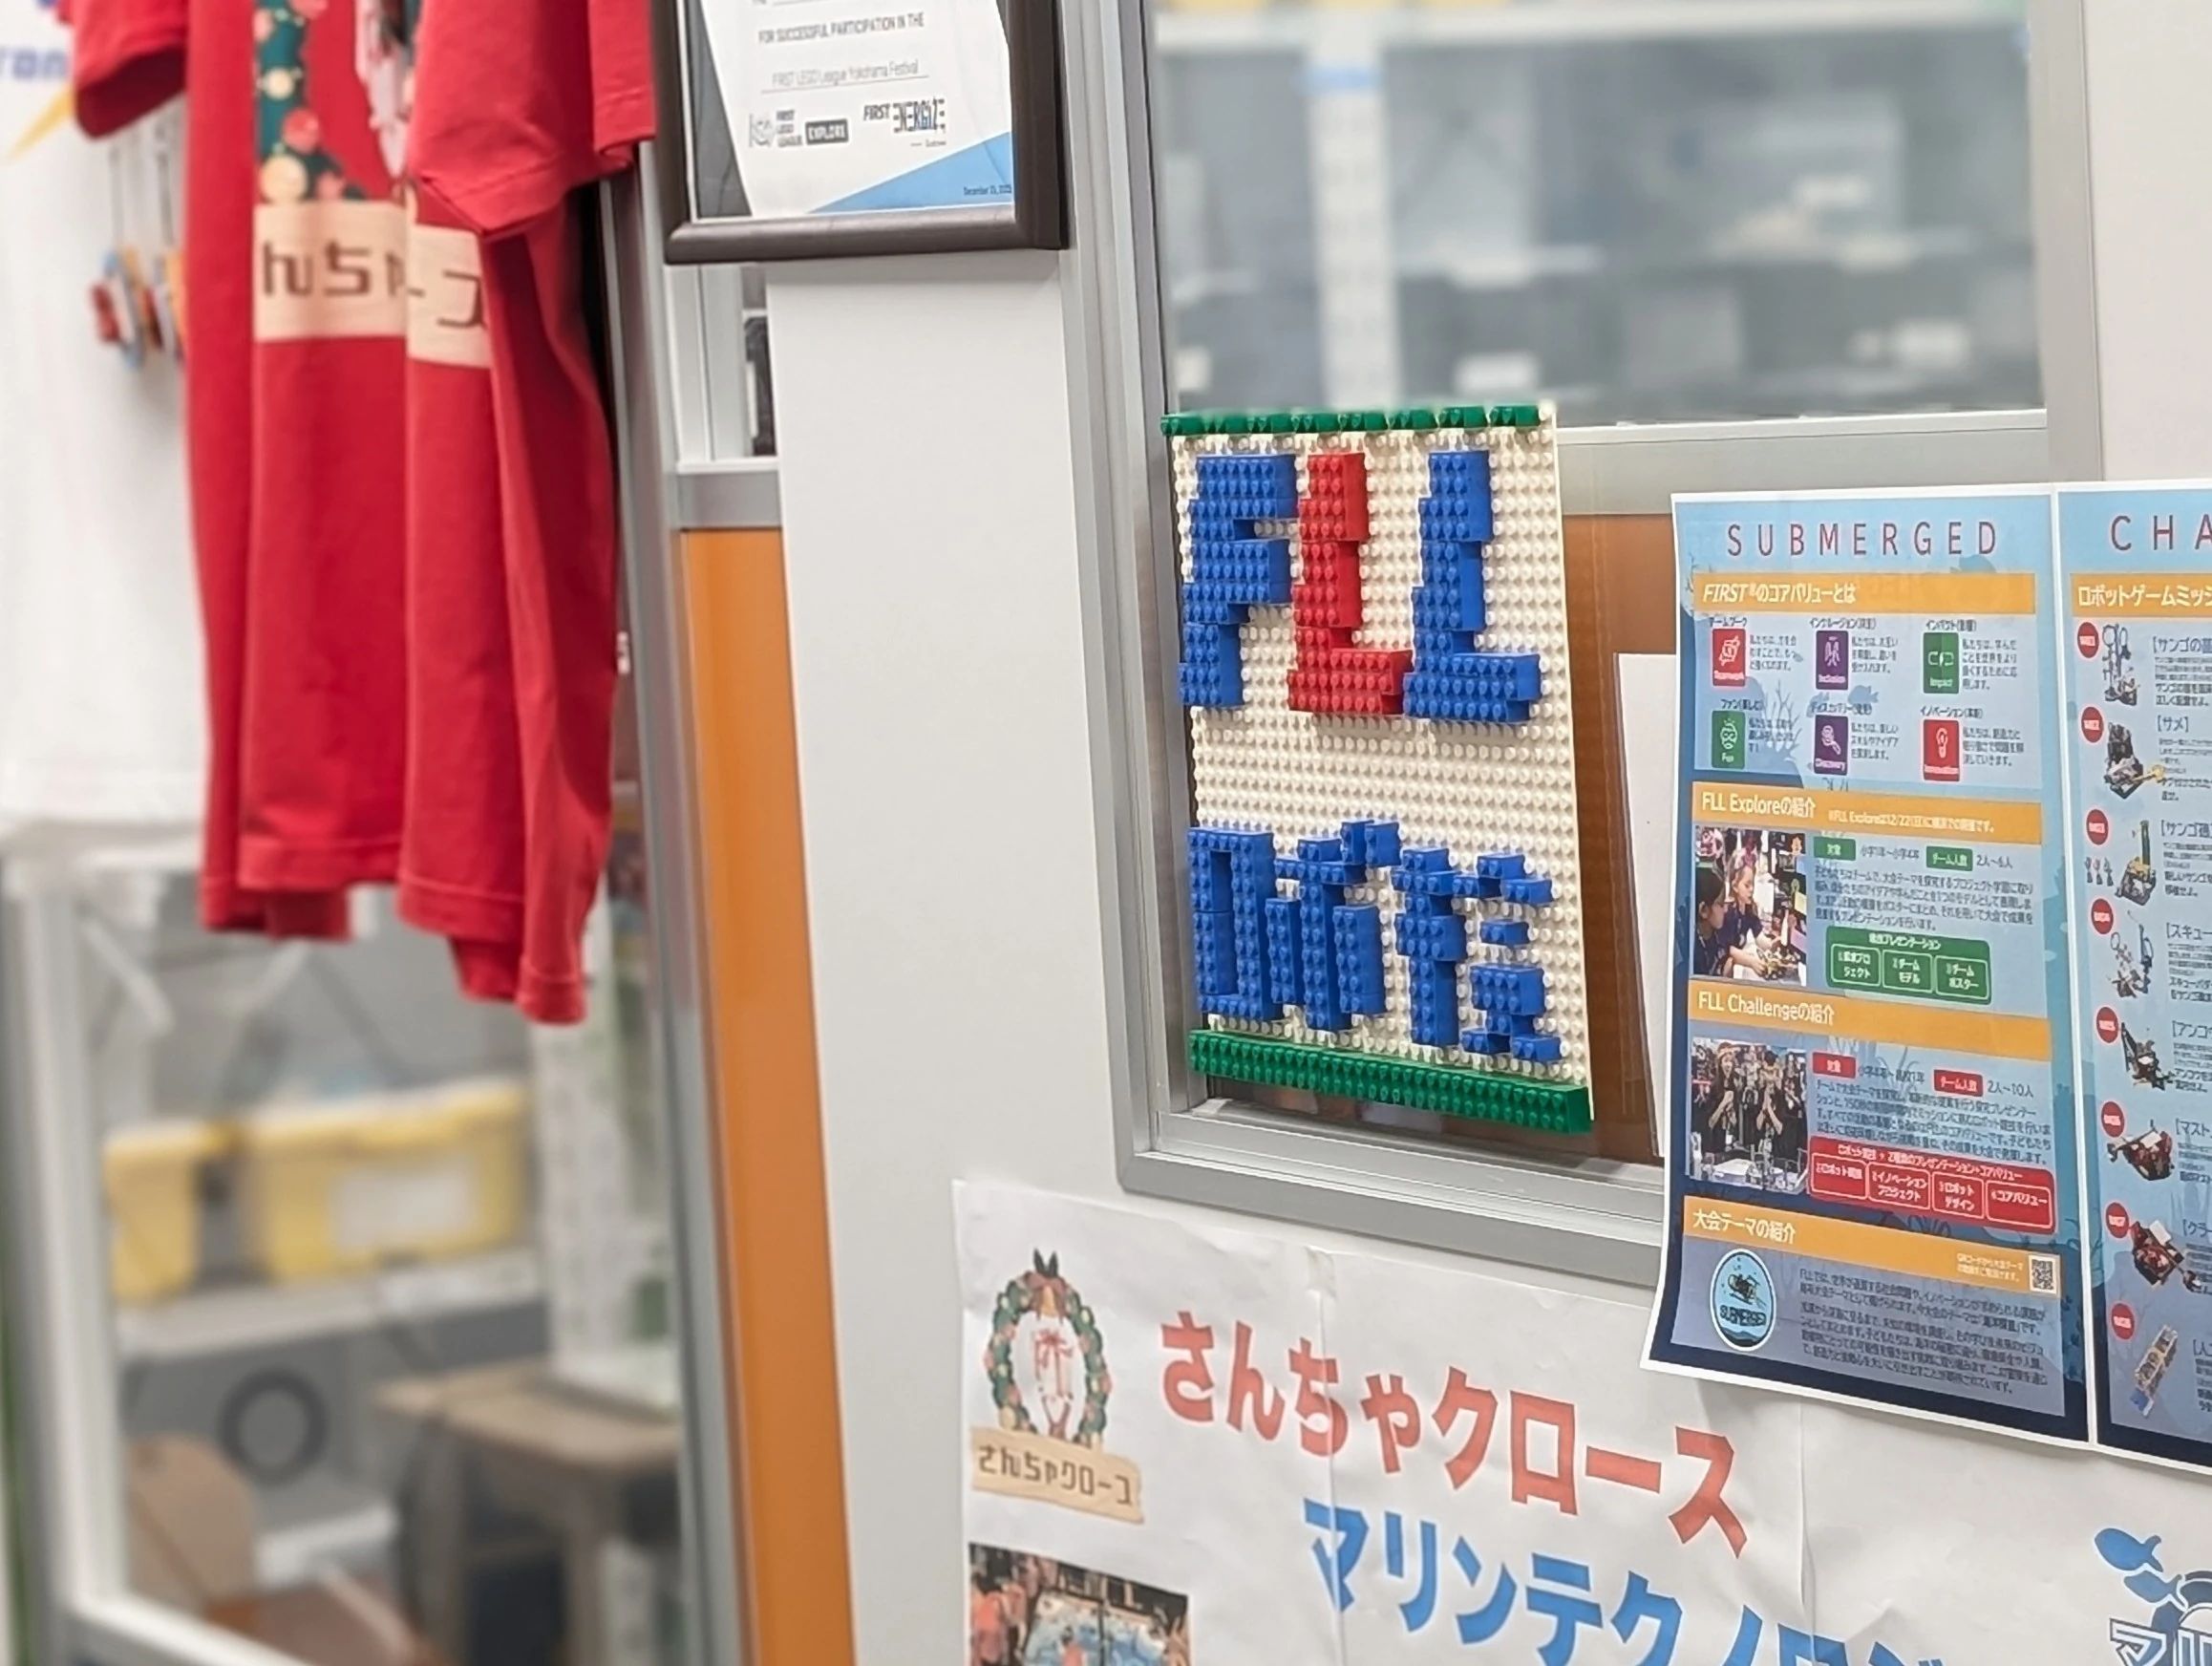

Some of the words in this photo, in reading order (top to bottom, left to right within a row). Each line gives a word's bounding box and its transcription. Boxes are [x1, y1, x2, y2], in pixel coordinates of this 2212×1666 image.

[758, 30, 775, 44] FOR
[831, 16, 895, 35] PARTICIPATION
[907, 11, 924, 27] THE
[863, 103, 890, 120] FIRST
[1727, 521, 1996, 557] SUBMERGED
[2111, 514, 2212, 551] CHA
[1702, 794, 1726, 811] FLL
[1730, 794, 1815, 821] Exploreの紹介
[1698, 992, 1724, 1012] FLL
[1727, 993, 1835, 1026] Challengeの紹介
[1692, 1210, 1796, 1245] 大会テーマの紹介
[1161, 1311, 1749, 1558] さんちゃクロース
